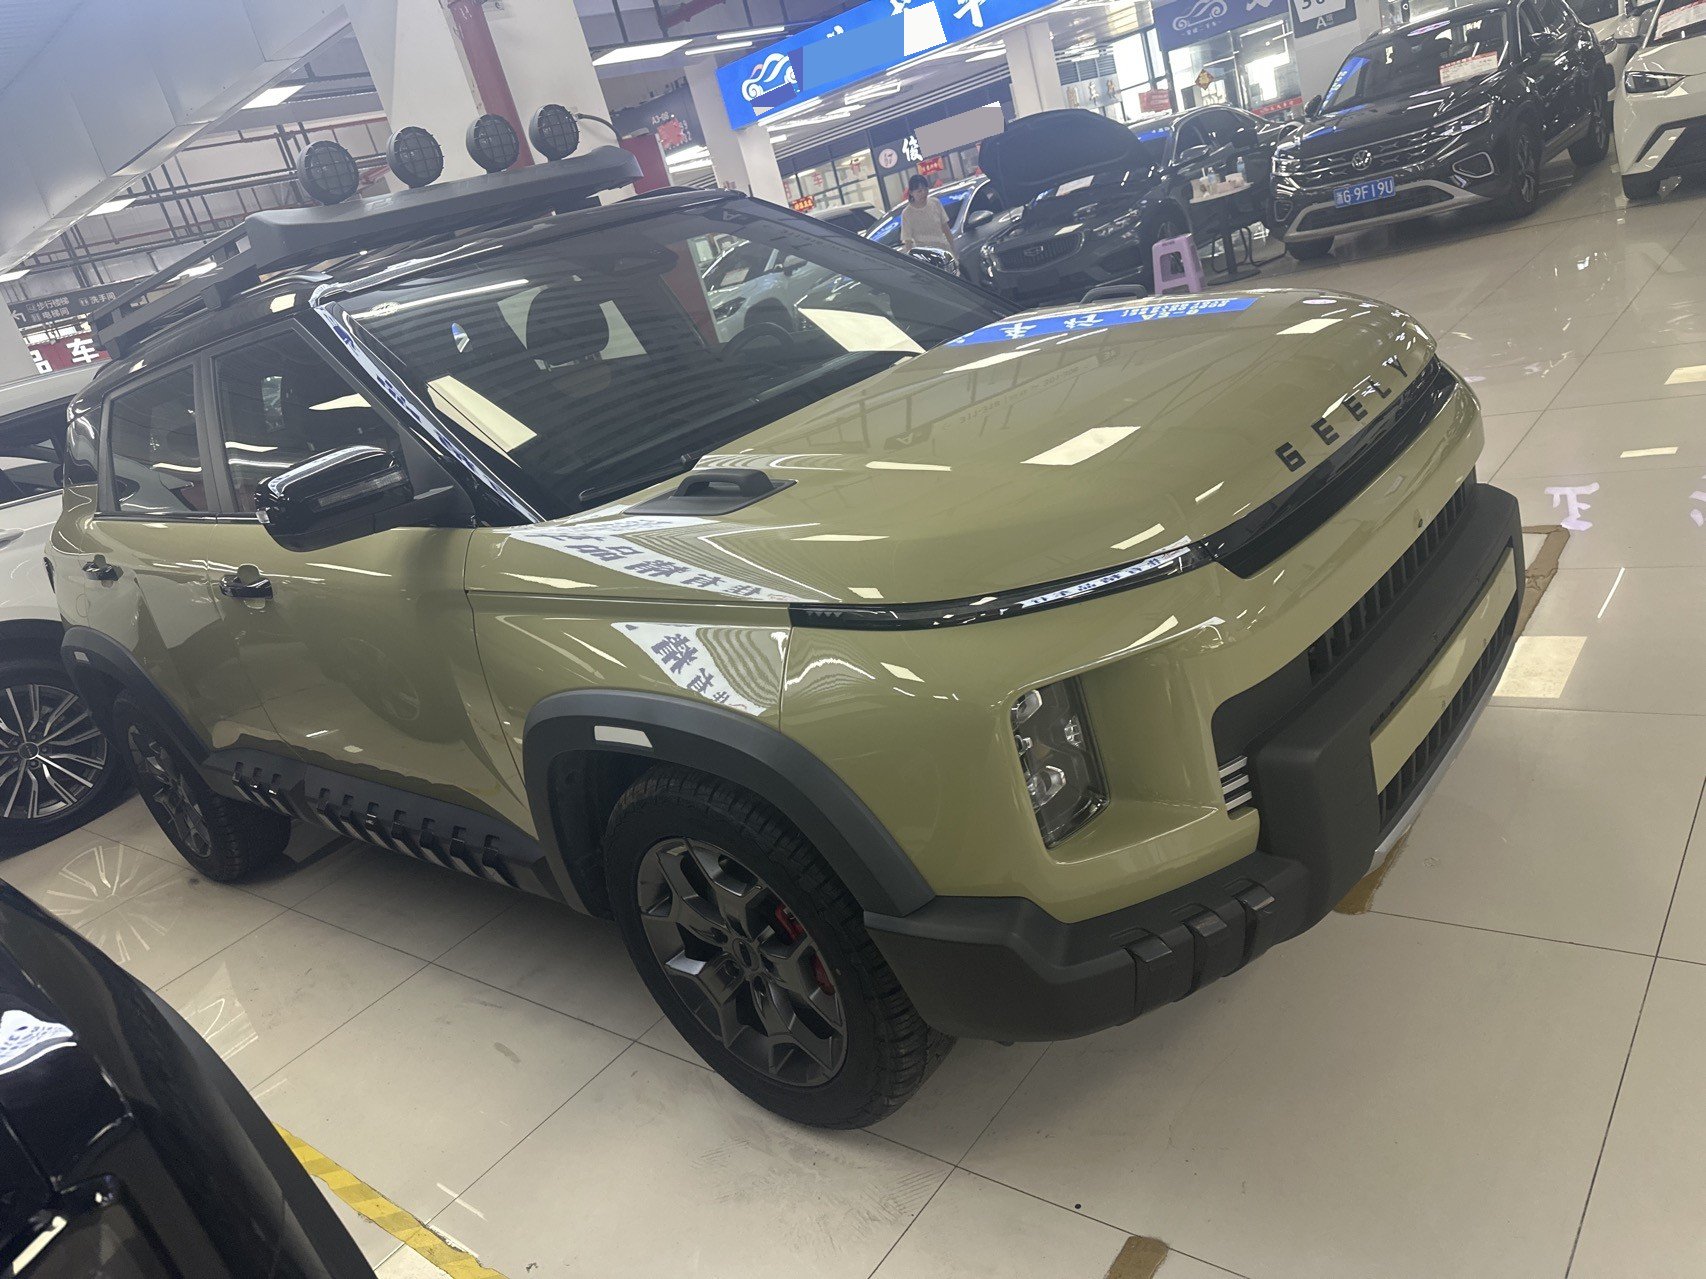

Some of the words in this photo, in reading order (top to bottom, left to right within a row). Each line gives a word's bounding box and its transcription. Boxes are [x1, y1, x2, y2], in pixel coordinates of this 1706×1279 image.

[36, 296, 70, 310] 步行楼梯
[89, 291, 117, 305] 洗手间
[42, 307, 70, 319] 电梯间
[1275, 358, 1409, 472] GEELY
